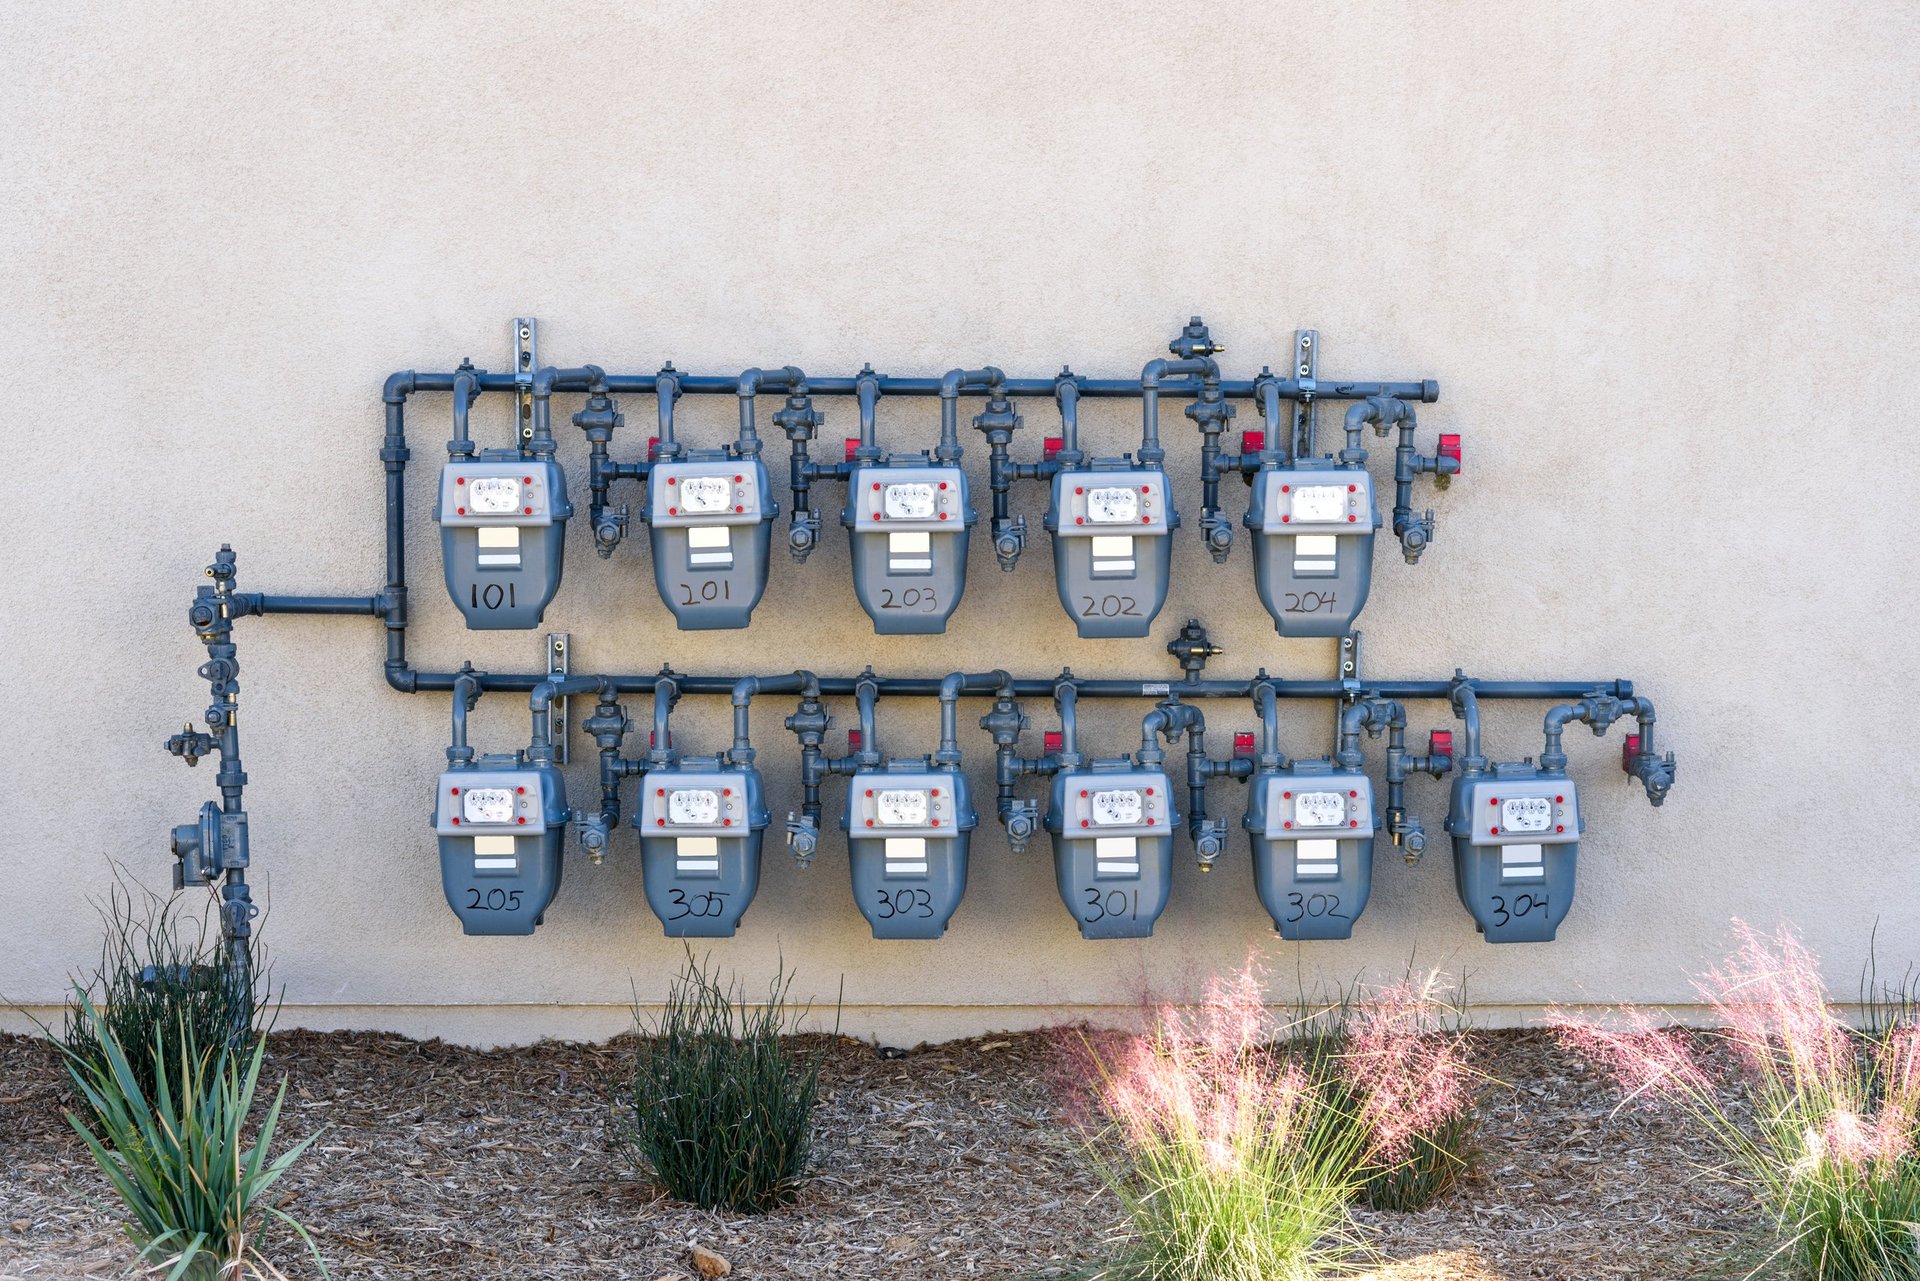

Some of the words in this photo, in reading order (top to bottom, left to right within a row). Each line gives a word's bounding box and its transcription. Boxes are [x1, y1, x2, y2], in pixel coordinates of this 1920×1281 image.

[471, 582, 515, 610] 101
[680, 579, 730, 606] 201
[881, 587, 937, 612] 203
[1082, 595, 1143, 616] 202
[1285, 591, 1337, 614] 204
[466, 887, 525, 912] 205
[667, 888, 731, 921] 305
[876, 888, 934, 919] 303
[1083, 887, 1138, 923] 301
[1286, 892, 1350, 923] 302
[1491, 893, 1550, 927] 304
